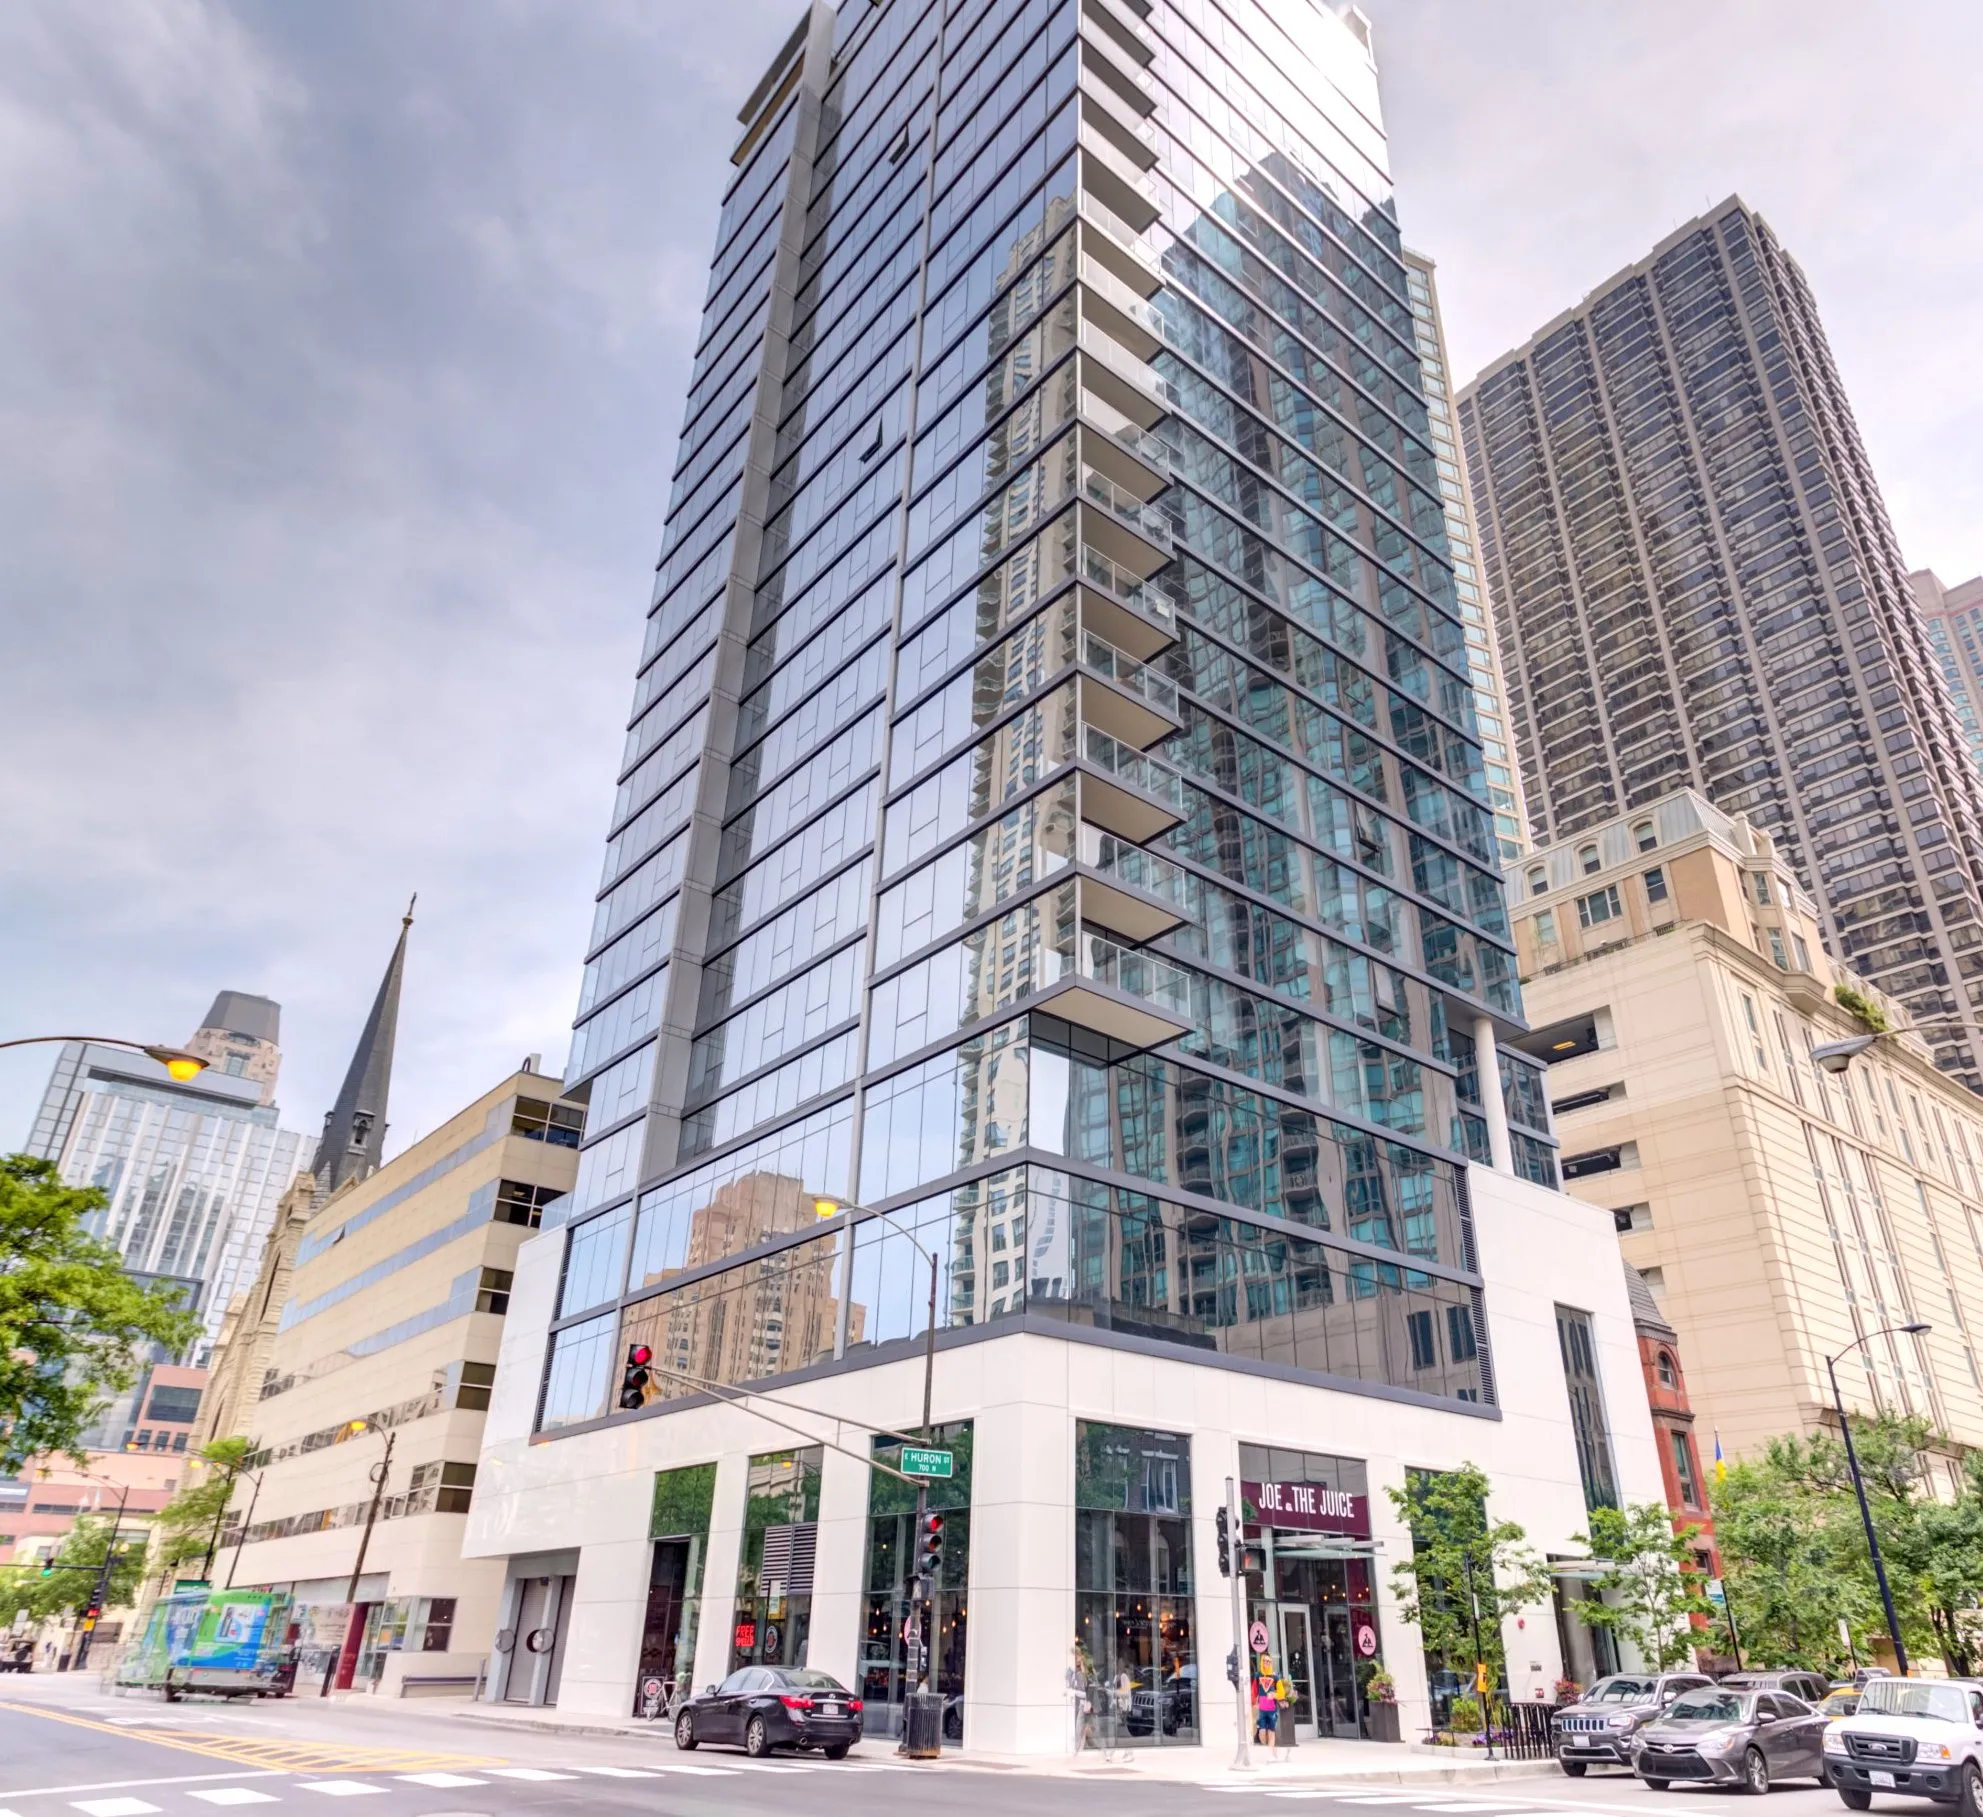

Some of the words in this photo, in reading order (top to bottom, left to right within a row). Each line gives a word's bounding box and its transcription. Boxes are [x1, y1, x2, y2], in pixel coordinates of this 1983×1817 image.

[911, 1453, 942, 1464] HURON
[919, 1464, 930, 1472] 700
[1259, 1482, 1283, 1511] JOE
[1291, 1485, 1317, 1514] THE
[1319, 1489, 1355, 1518] JUICE
